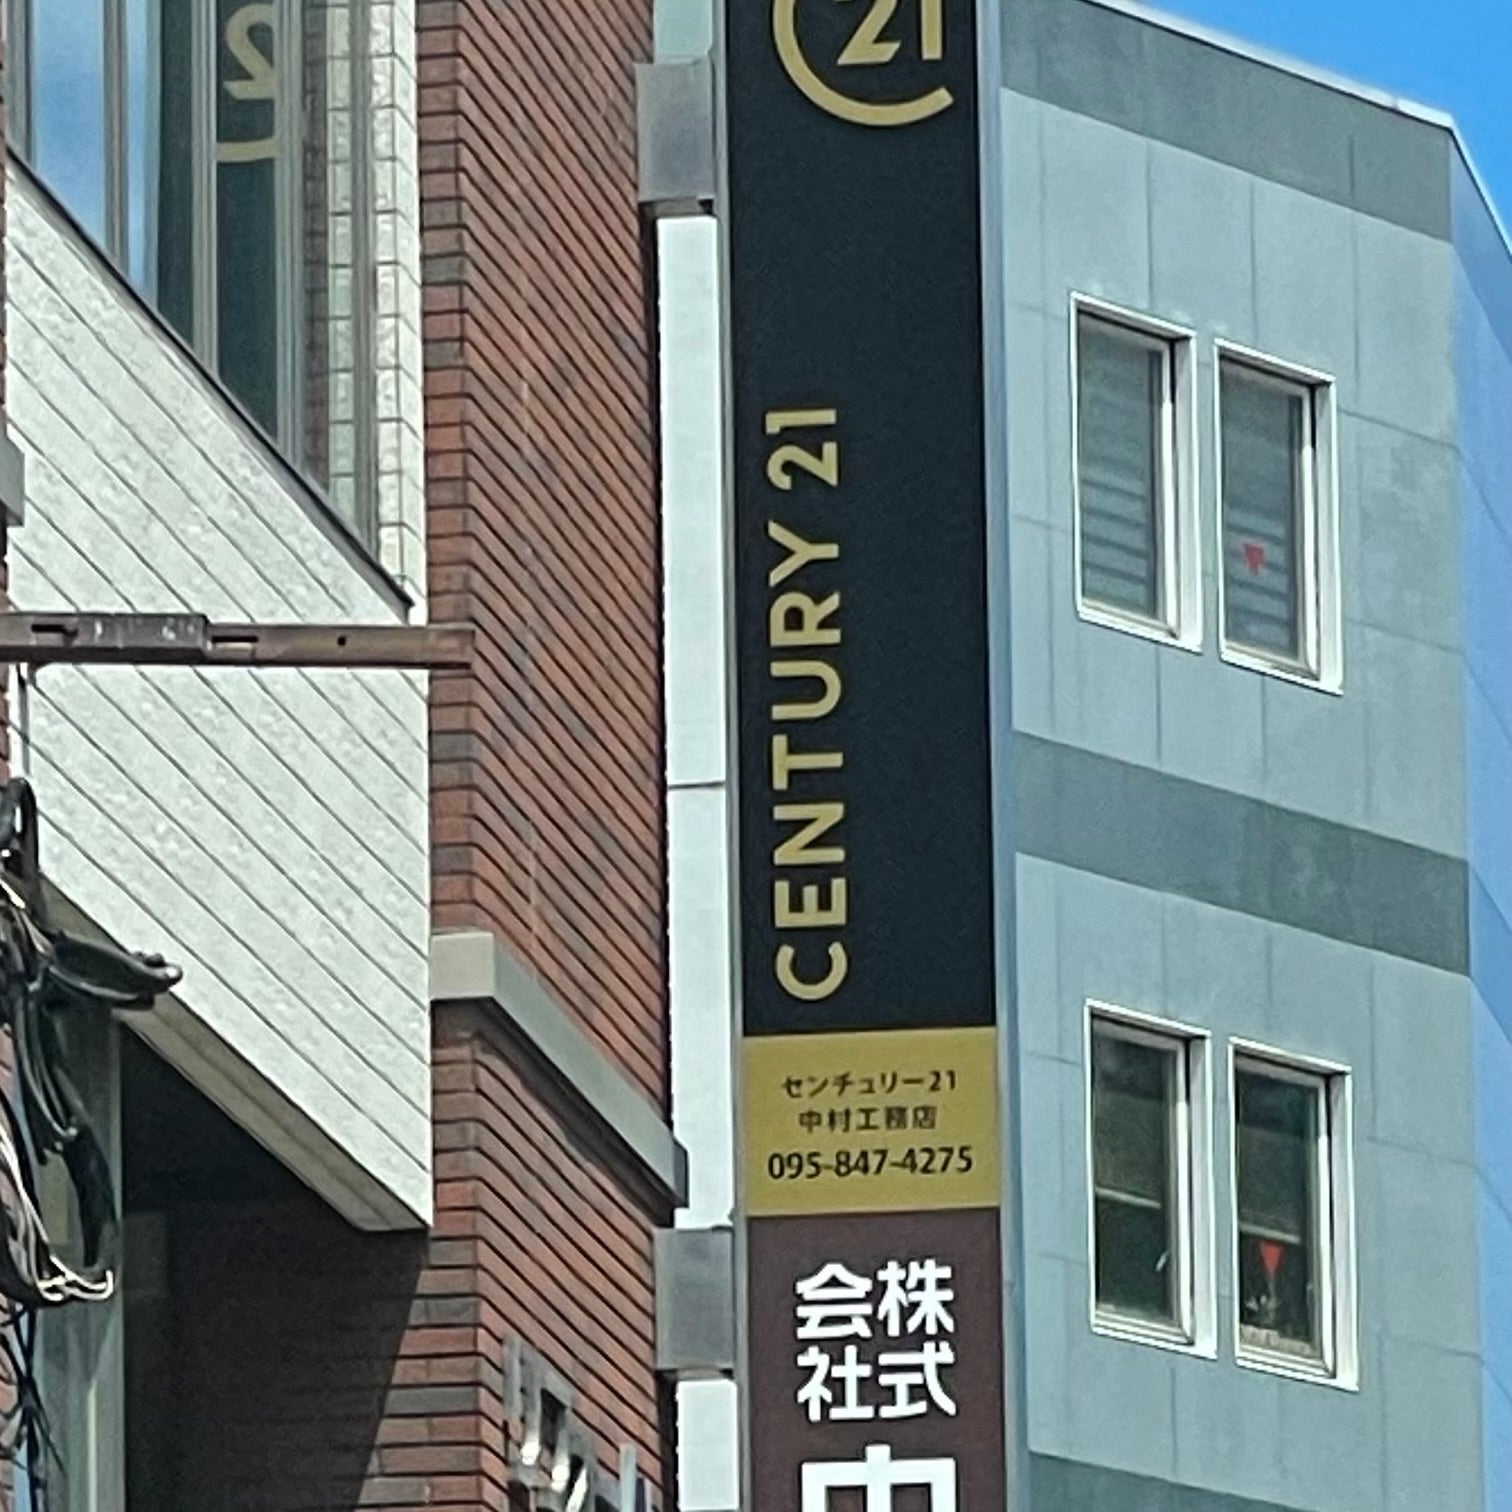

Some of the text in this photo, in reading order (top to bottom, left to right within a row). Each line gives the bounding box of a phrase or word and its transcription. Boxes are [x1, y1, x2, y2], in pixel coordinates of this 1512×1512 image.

[764, 407, 850, 1002] CENTURY 21
[781, 1069, 959, 1101] センチュリー21
[797, 1105, 939, 1134] 中村工務店
[766, 1144, 974, 1181] 095-847-4275
